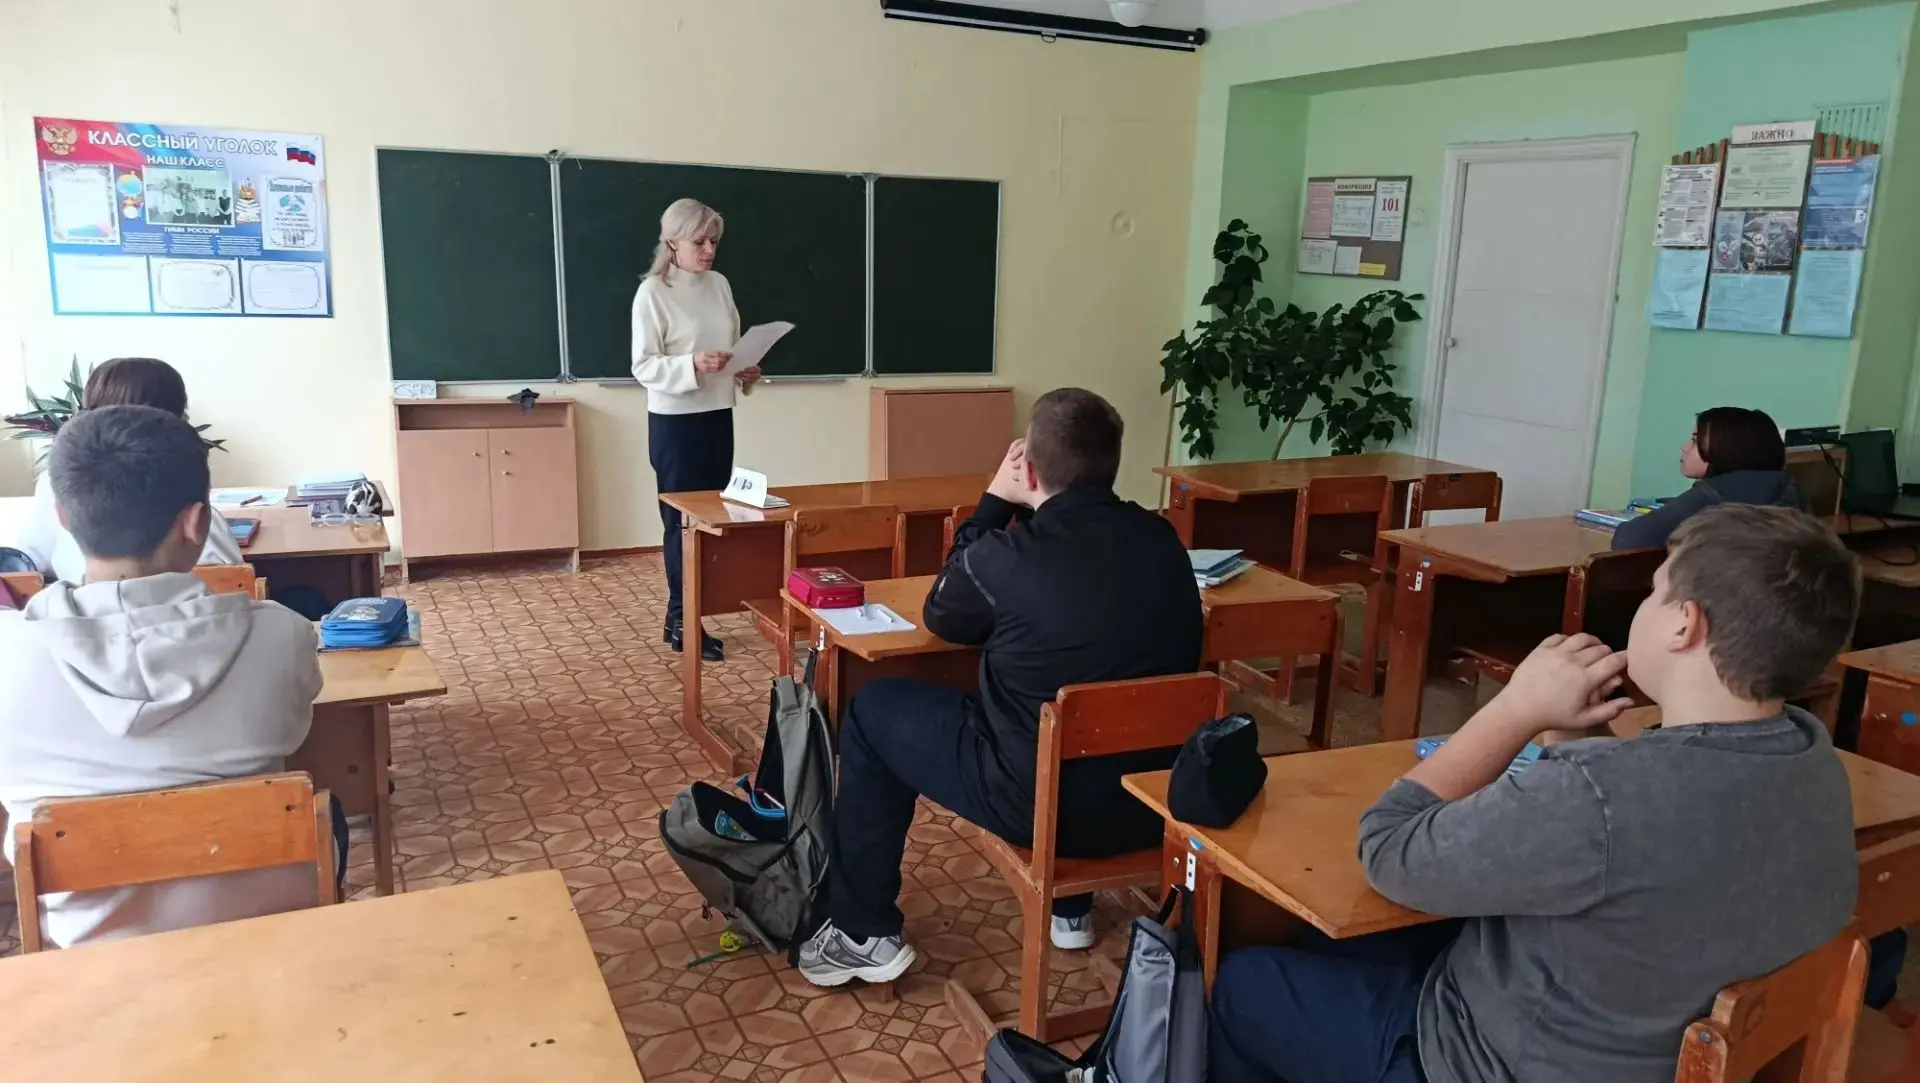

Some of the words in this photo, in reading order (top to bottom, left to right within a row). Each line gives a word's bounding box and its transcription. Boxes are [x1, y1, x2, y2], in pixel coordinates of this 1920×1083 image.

[1751, 129, 1794, 140] ВАЖНО
[88, 130, 199, 150] КЛАССНЫЙ
[204, 137, 278, 155] УГОЛОК
[147, 154, 177, 165] НАШ
[180, 156, 225, 168] КЛАСС
[1382, 198, 1400, 212] 101
